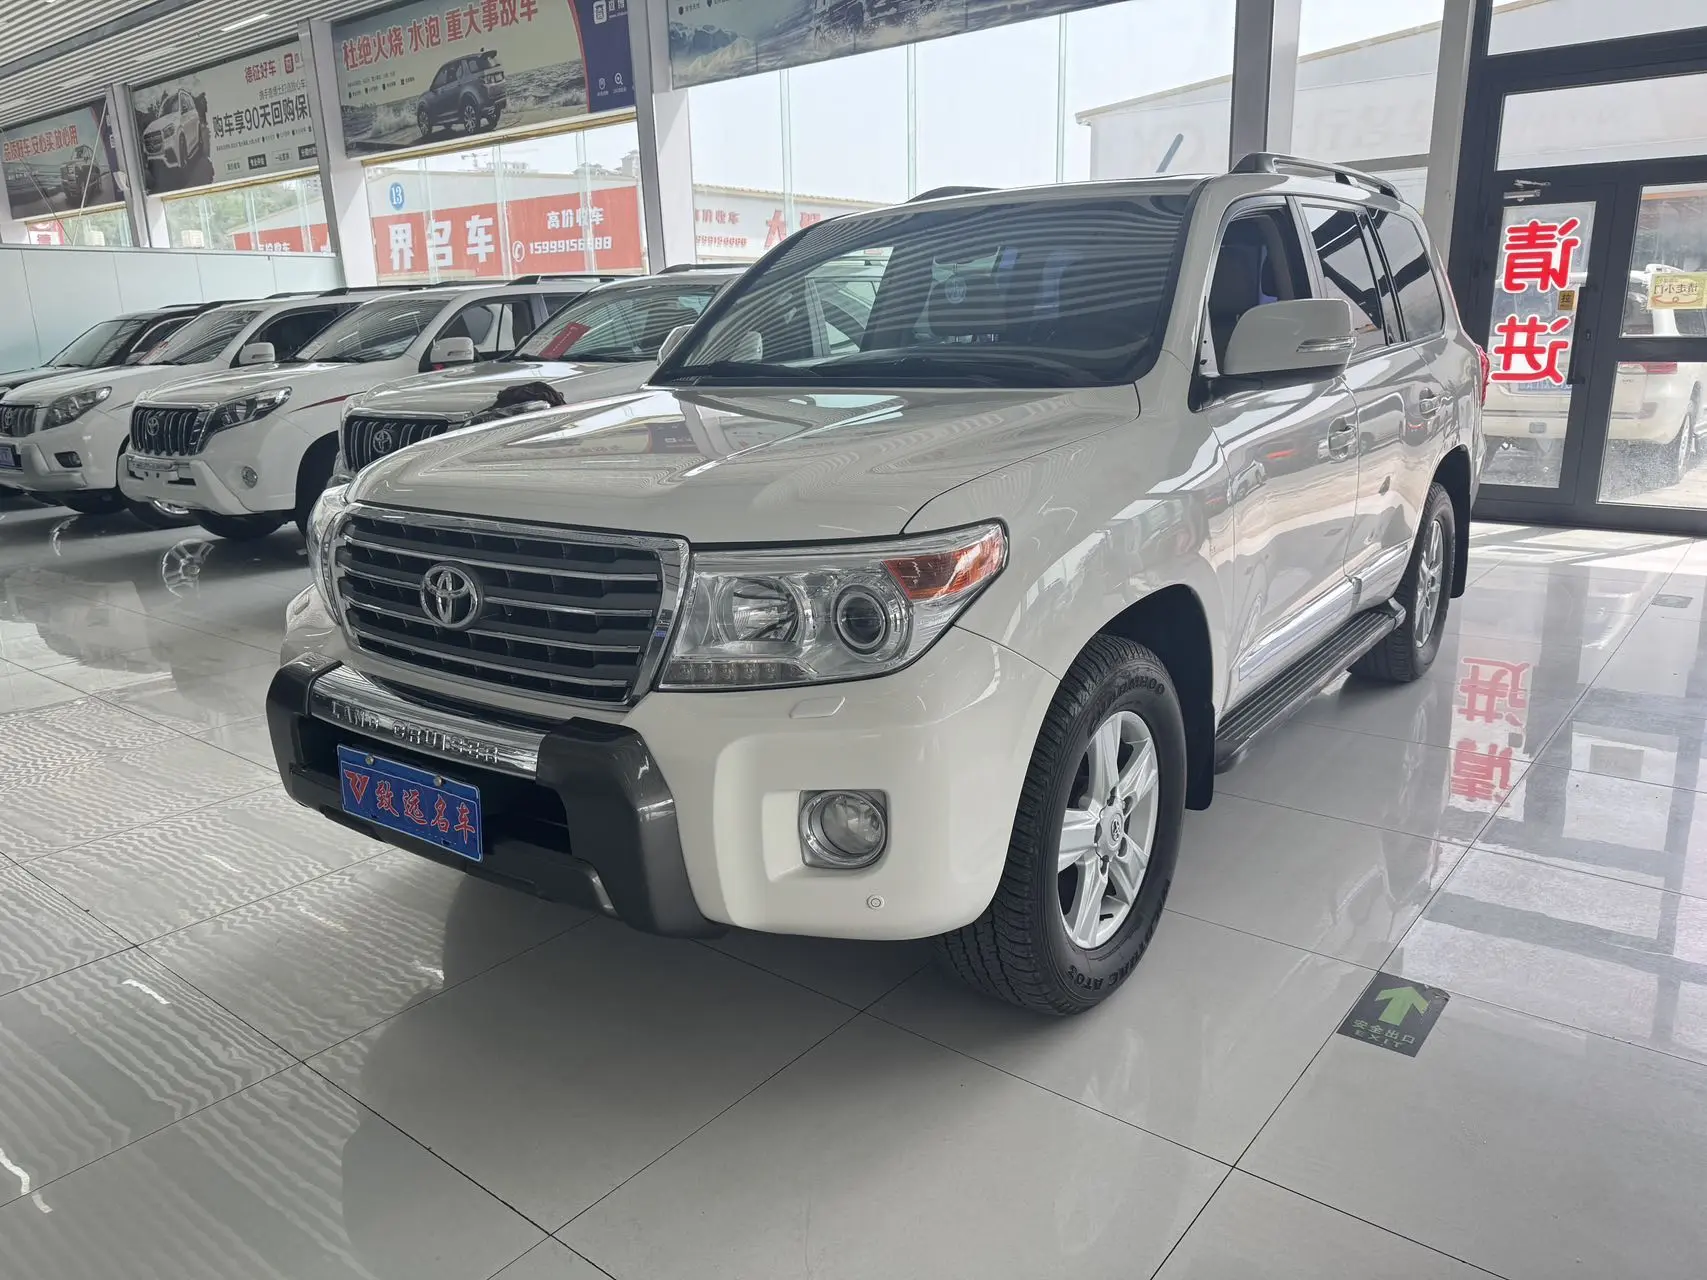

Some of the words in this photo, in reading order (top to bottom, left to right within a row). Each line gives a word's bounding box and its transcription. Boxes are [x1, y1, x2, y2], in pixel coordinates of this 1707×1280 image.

[342, 26, 404, 71] 杜绝火烧
[407, 15, 441, 52] 水泡
[445, 0, 538, 42] 重大事故车
[212, 93, 311, 139] 购车享90天回购保
[391, 186, 403, 205] 13
[1352, 1019, 1416, 1045] 安全出口
